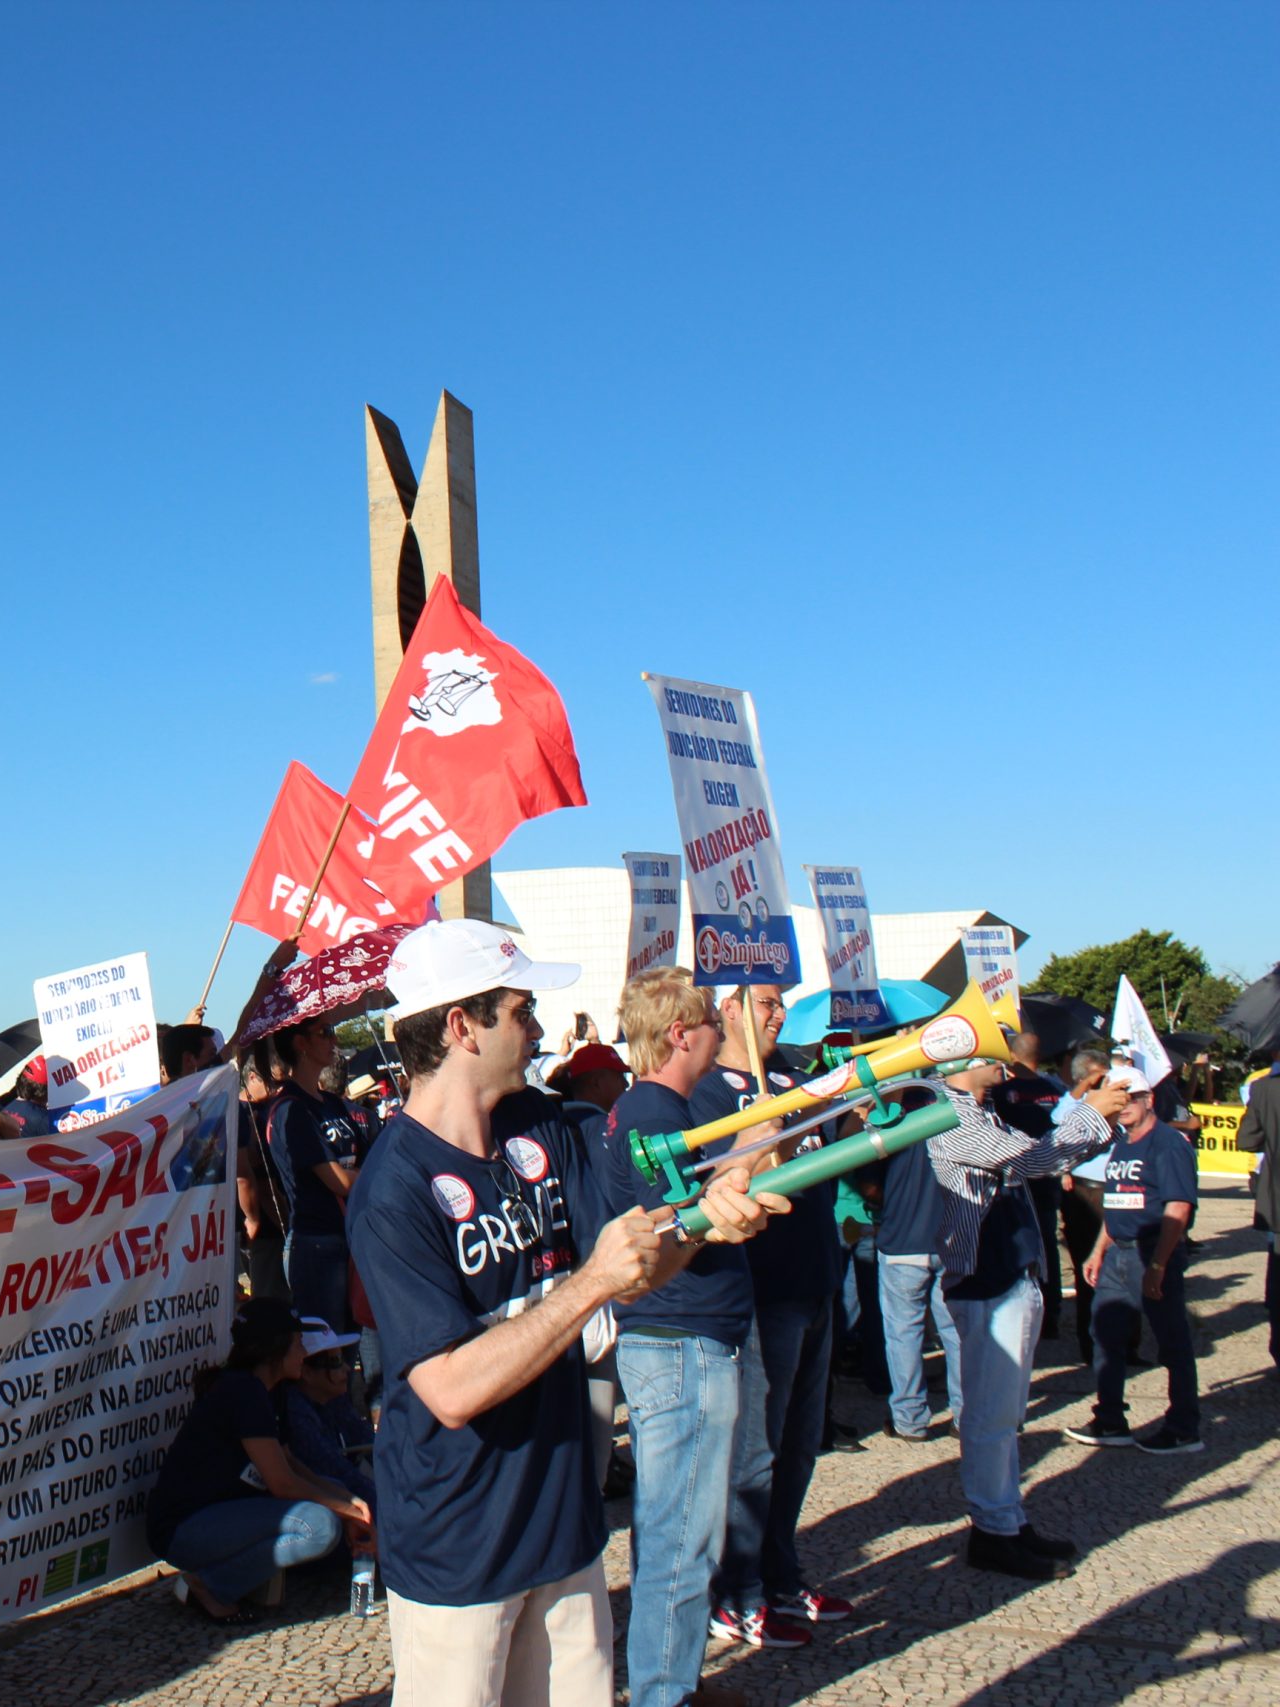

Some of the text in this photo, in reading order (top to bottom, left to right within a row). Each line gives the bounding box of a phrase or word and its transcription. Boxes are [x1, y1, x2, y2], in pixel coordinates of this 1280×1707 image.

[663, 687, 738, 725] SERVIDORES DO
[718, 739, 757, 768] FEDERAL
[703, 780, 740, 808] EXIGEM
[685, 807, 771, 875] VALORIZAÇÃO
[730, 858, 759, 901] JÁ!
[111, 965, 126, 980] DO
[721, 931, 790, 975] Sinjufego
[182, 1200, 225, 1264] JÁ!
[456, 1177, 568, 1275] GREVE
[100, 1310, 111, 1341] É
[111, 1304, 140, 1336] UMA
[144, 1282, 220, 1325] EXTRAÇÃO
[54, 1363, 79, 1394] EM
[80, 1343, 136, 1383] ÚLTIMA
[140, 1321, 217, 1365] INSTÂNCIA,
[25, 1392, 95, 1440] INVESTIR
[99, 1384, 130, 1413] NA
[20, 1439, 55, 1478] PAÍS
[62, 1433, 94, 1465] DO
[99, 1413, 160, 1454] FUTURO
[7, 1488, 44, 1520] UM
[49, 1464, 117, 1509] FUTURO
[122, 1450, 170, 1484] SÓLID
[15, 1574, 39, 1608] PI
